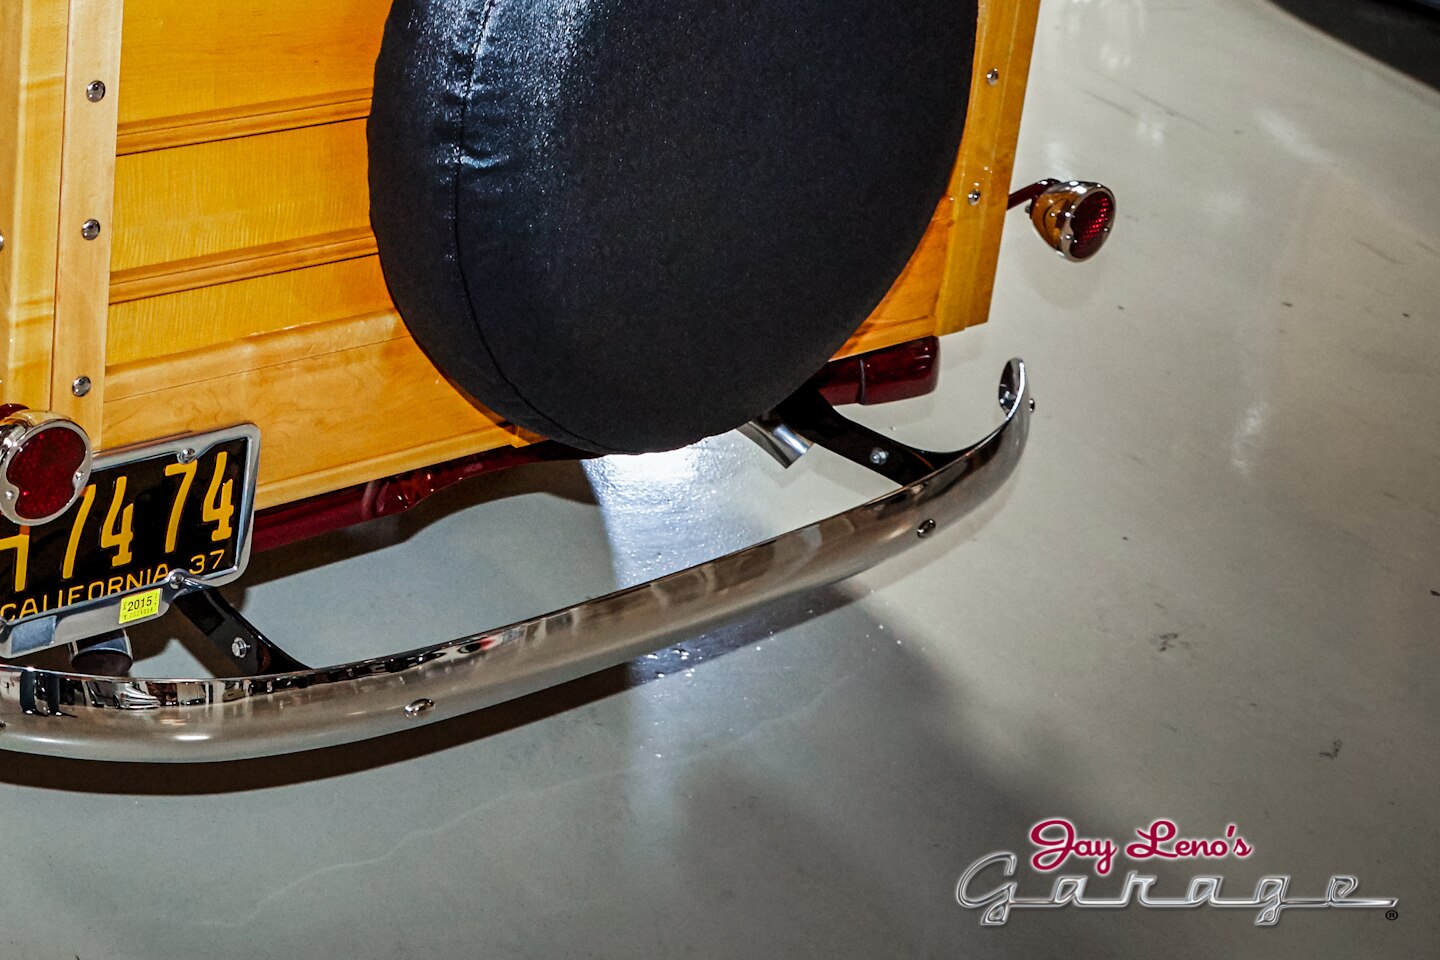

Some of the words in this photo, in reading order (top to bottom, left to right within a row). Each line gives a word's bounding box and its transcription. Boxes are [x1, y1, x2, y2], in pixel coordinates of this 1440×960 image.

[164, 451, 235, 554] 74
[189, 549, 226, 575] 37
[127, 595, 153, 612] 2015
